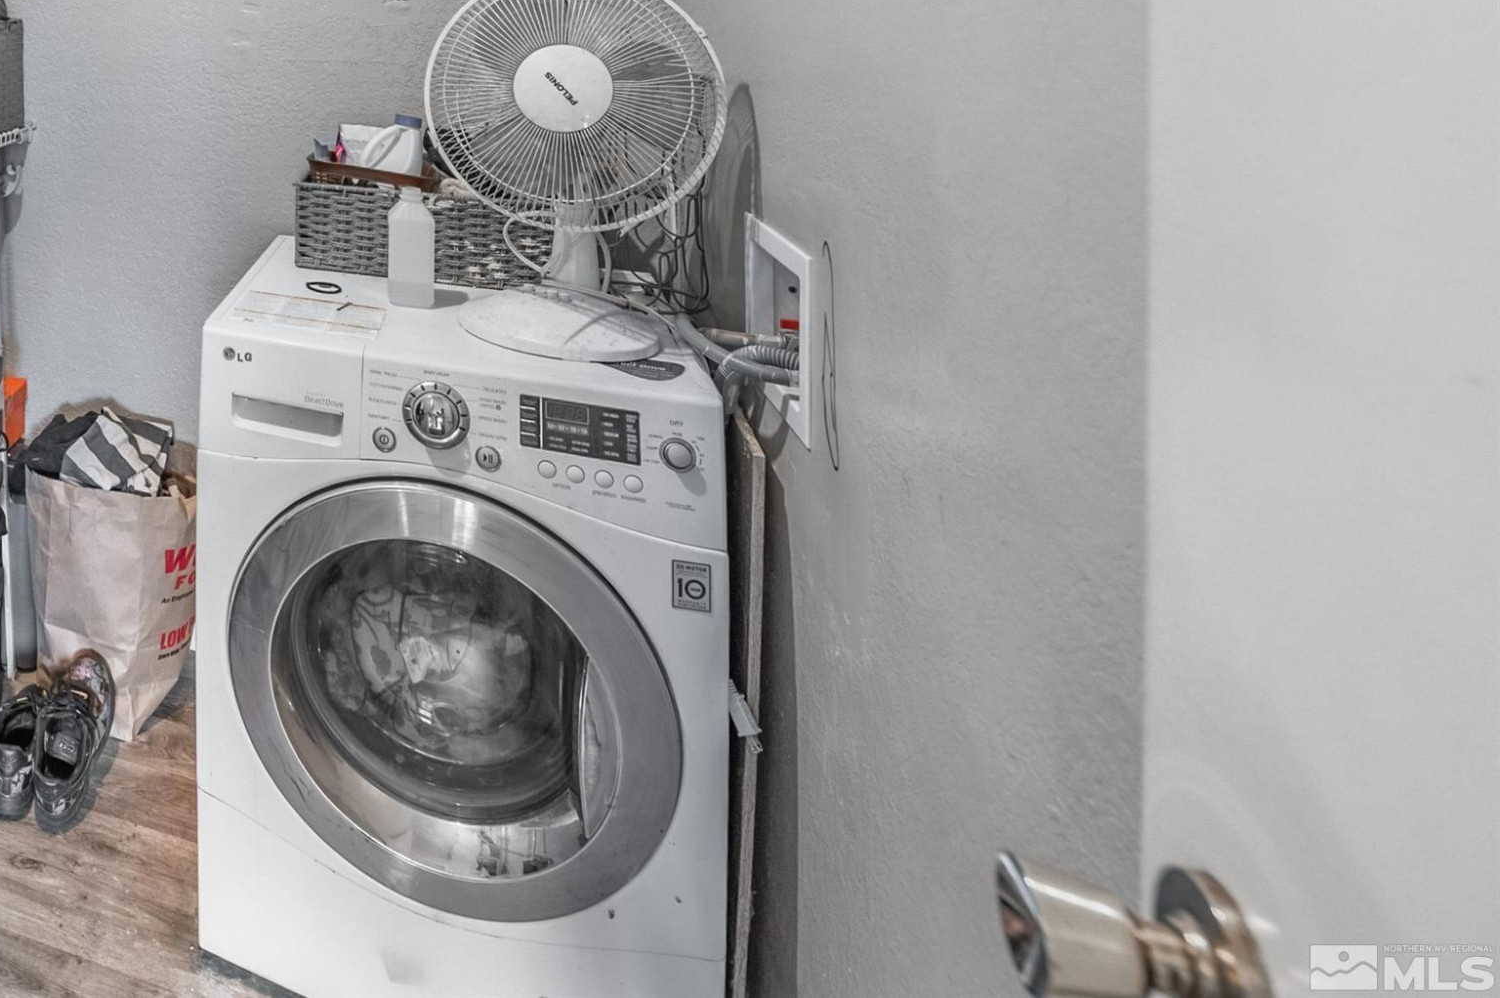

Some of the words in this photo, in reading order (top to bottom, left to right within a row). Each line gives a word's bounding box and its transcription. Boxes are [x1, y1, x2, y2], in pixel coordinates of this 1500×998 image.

[544, 72, 578, 106] PELONIS
[237, 352, 252, 362] LG
[678, 578, 706, 600] 10
[160, 620, 188, 651] LOW
